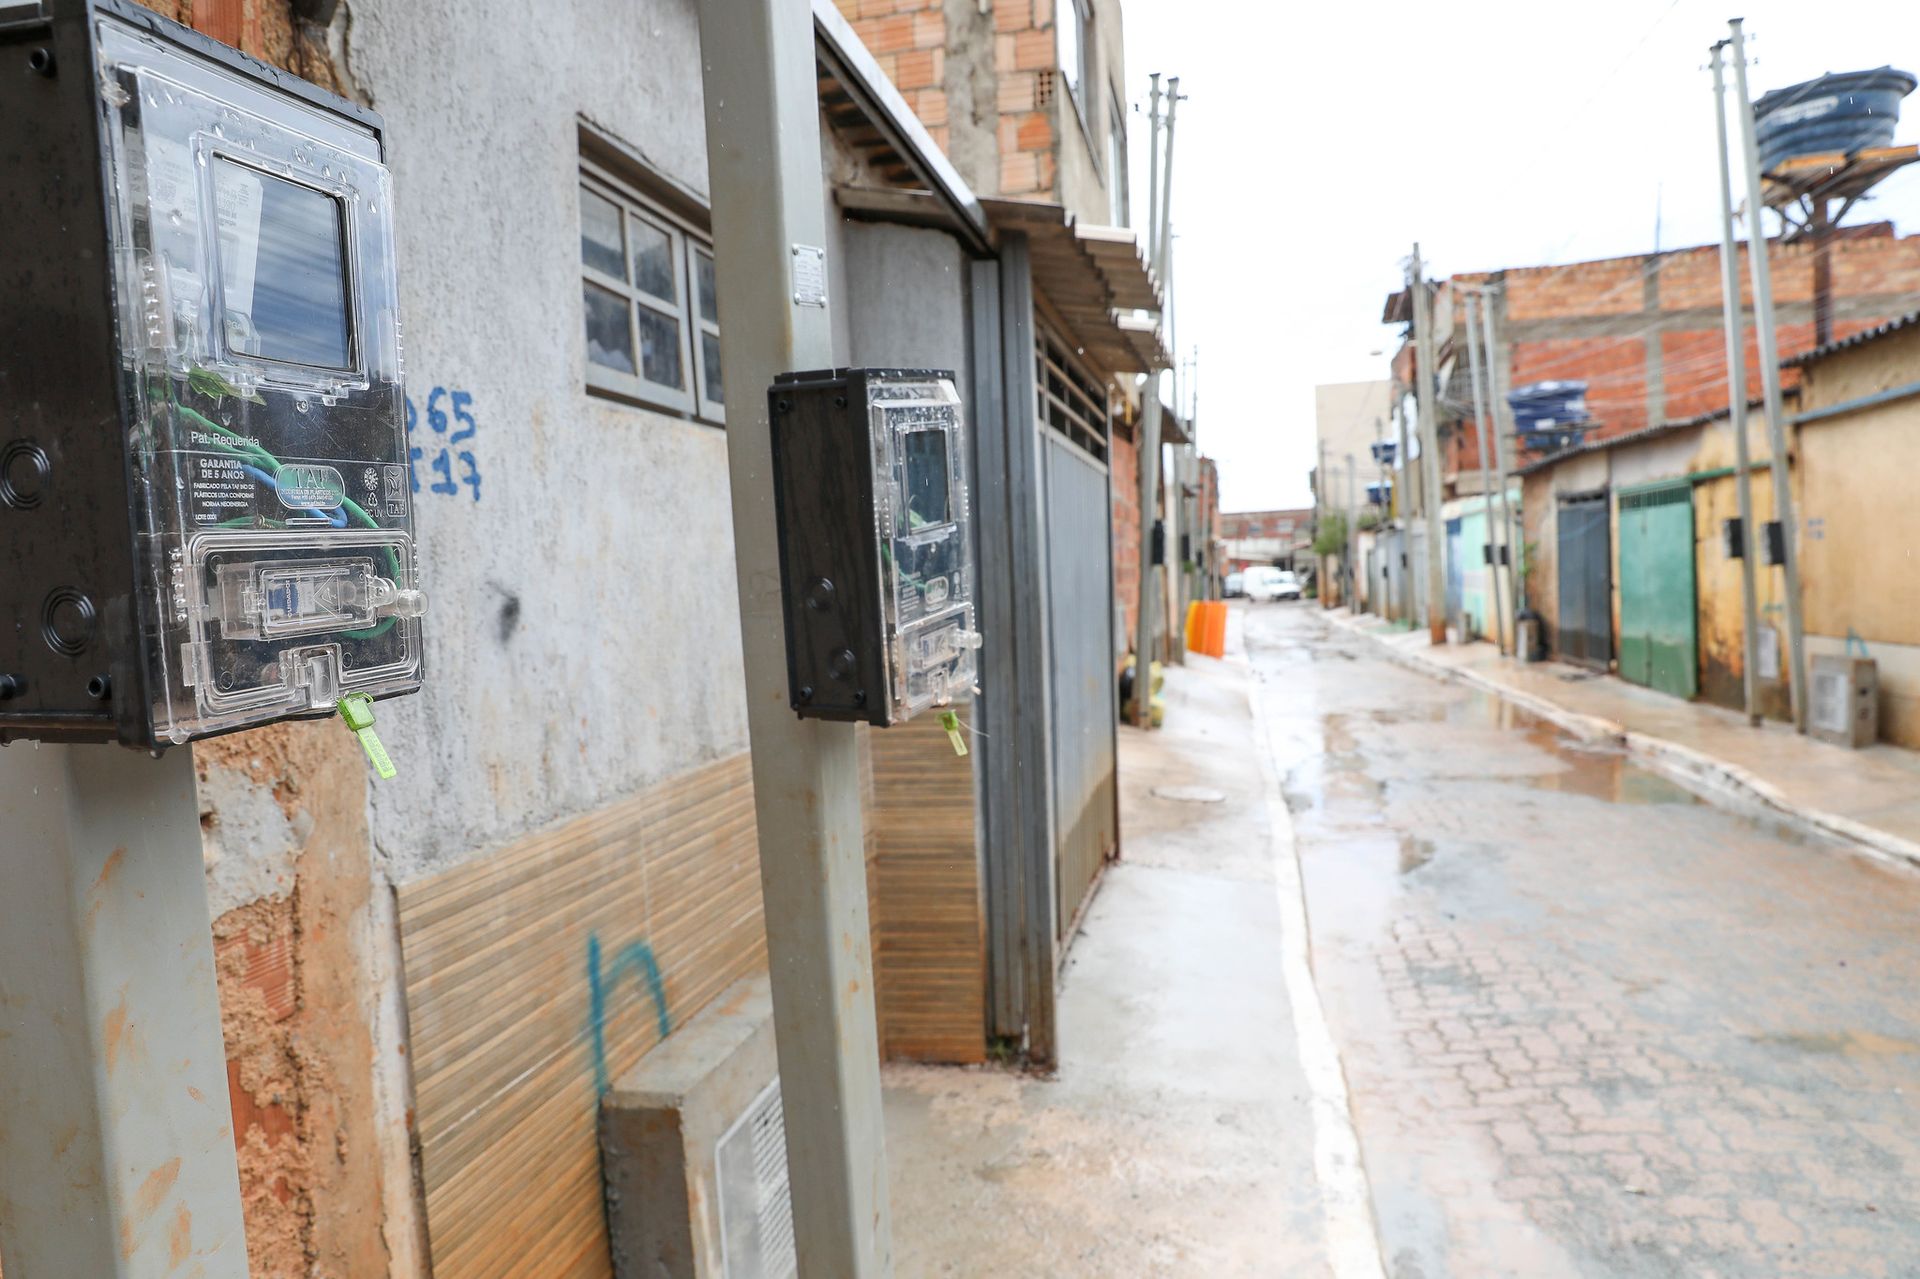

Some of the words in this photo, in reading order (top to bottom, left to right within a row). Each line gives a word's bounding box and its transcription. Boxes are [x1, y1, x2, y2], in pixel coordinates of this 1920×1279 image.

[191, 431, 211, 444] Pat.
[213, 433, 260, 448] Requerida
[200, 459, 242, 469] GARANTIA
[201, 469, 213, 479] DE
[214, 470, 220, 479] 5
[221, 470, 245, 480] ANOS
[291, 467, 329, 489] TAF
[388, 503, 405, 514] TAF
